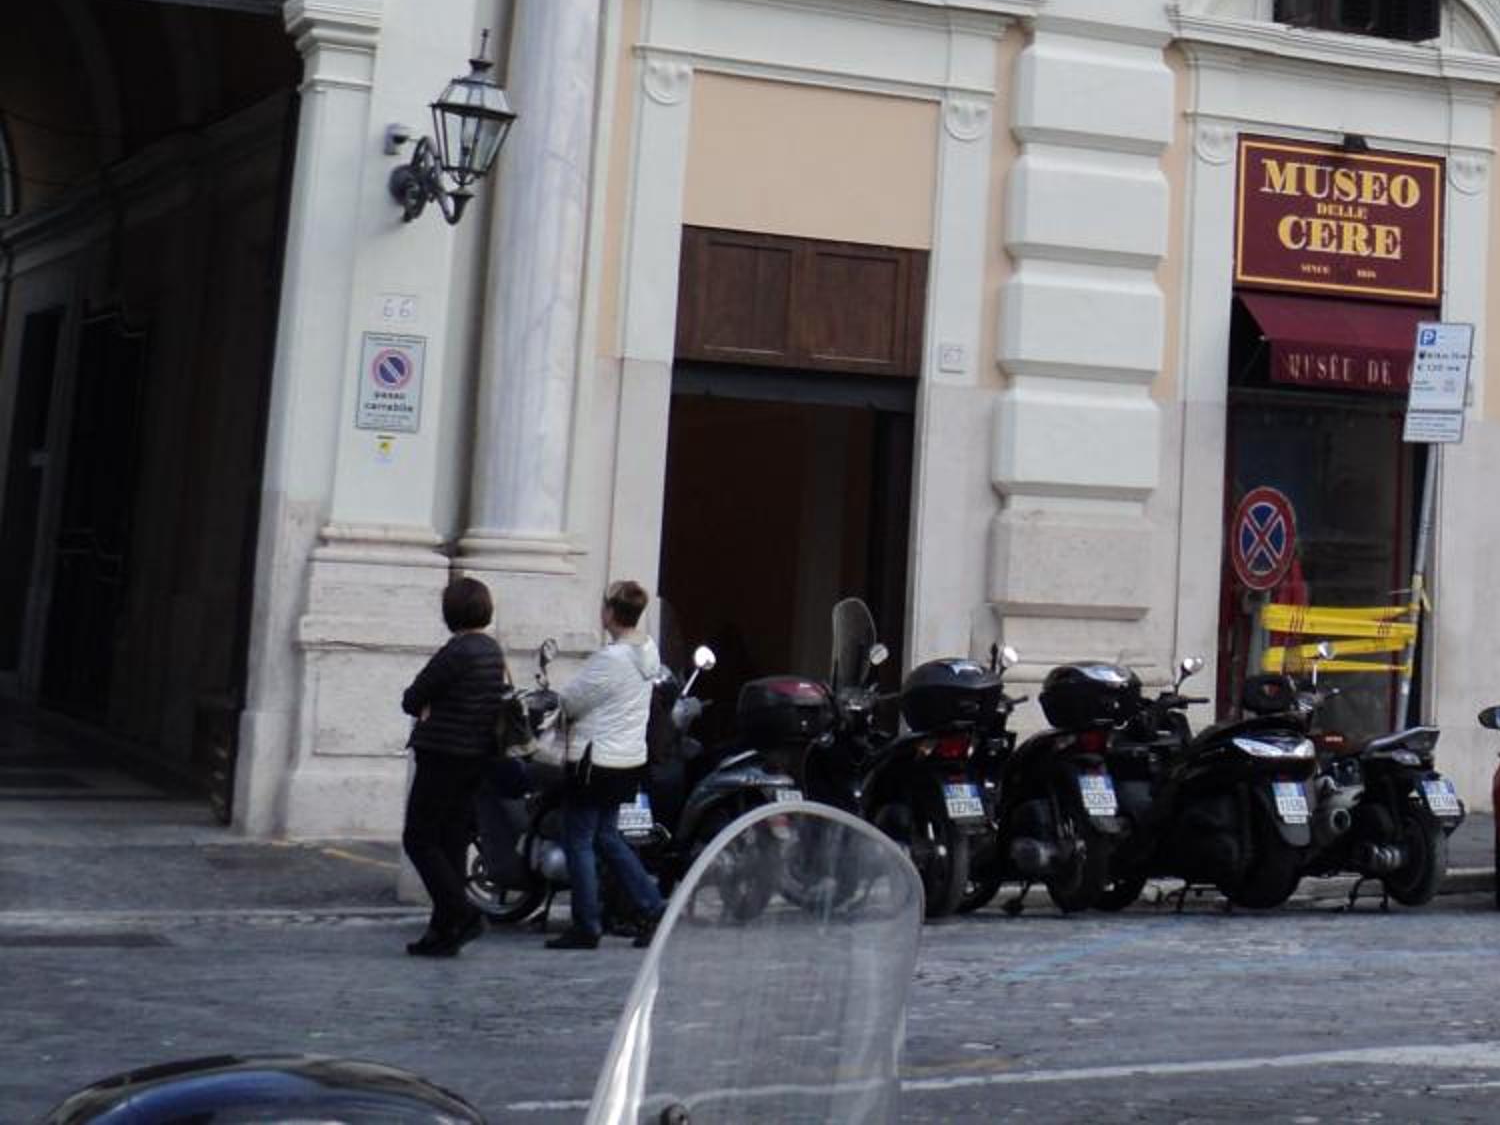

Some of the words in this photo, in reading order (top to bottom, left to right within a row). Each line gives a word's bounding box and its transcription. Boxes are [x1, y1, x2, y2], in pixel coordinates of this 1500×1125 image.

[1260, 158, 1421, 209] MUSEO
[1316, 202, 1368, 220] DELLE
[1277, 215, 1402, 260] CERE
[1366, 359, 1392, 385] DE
[364, 402, 414, 413] carrabile
